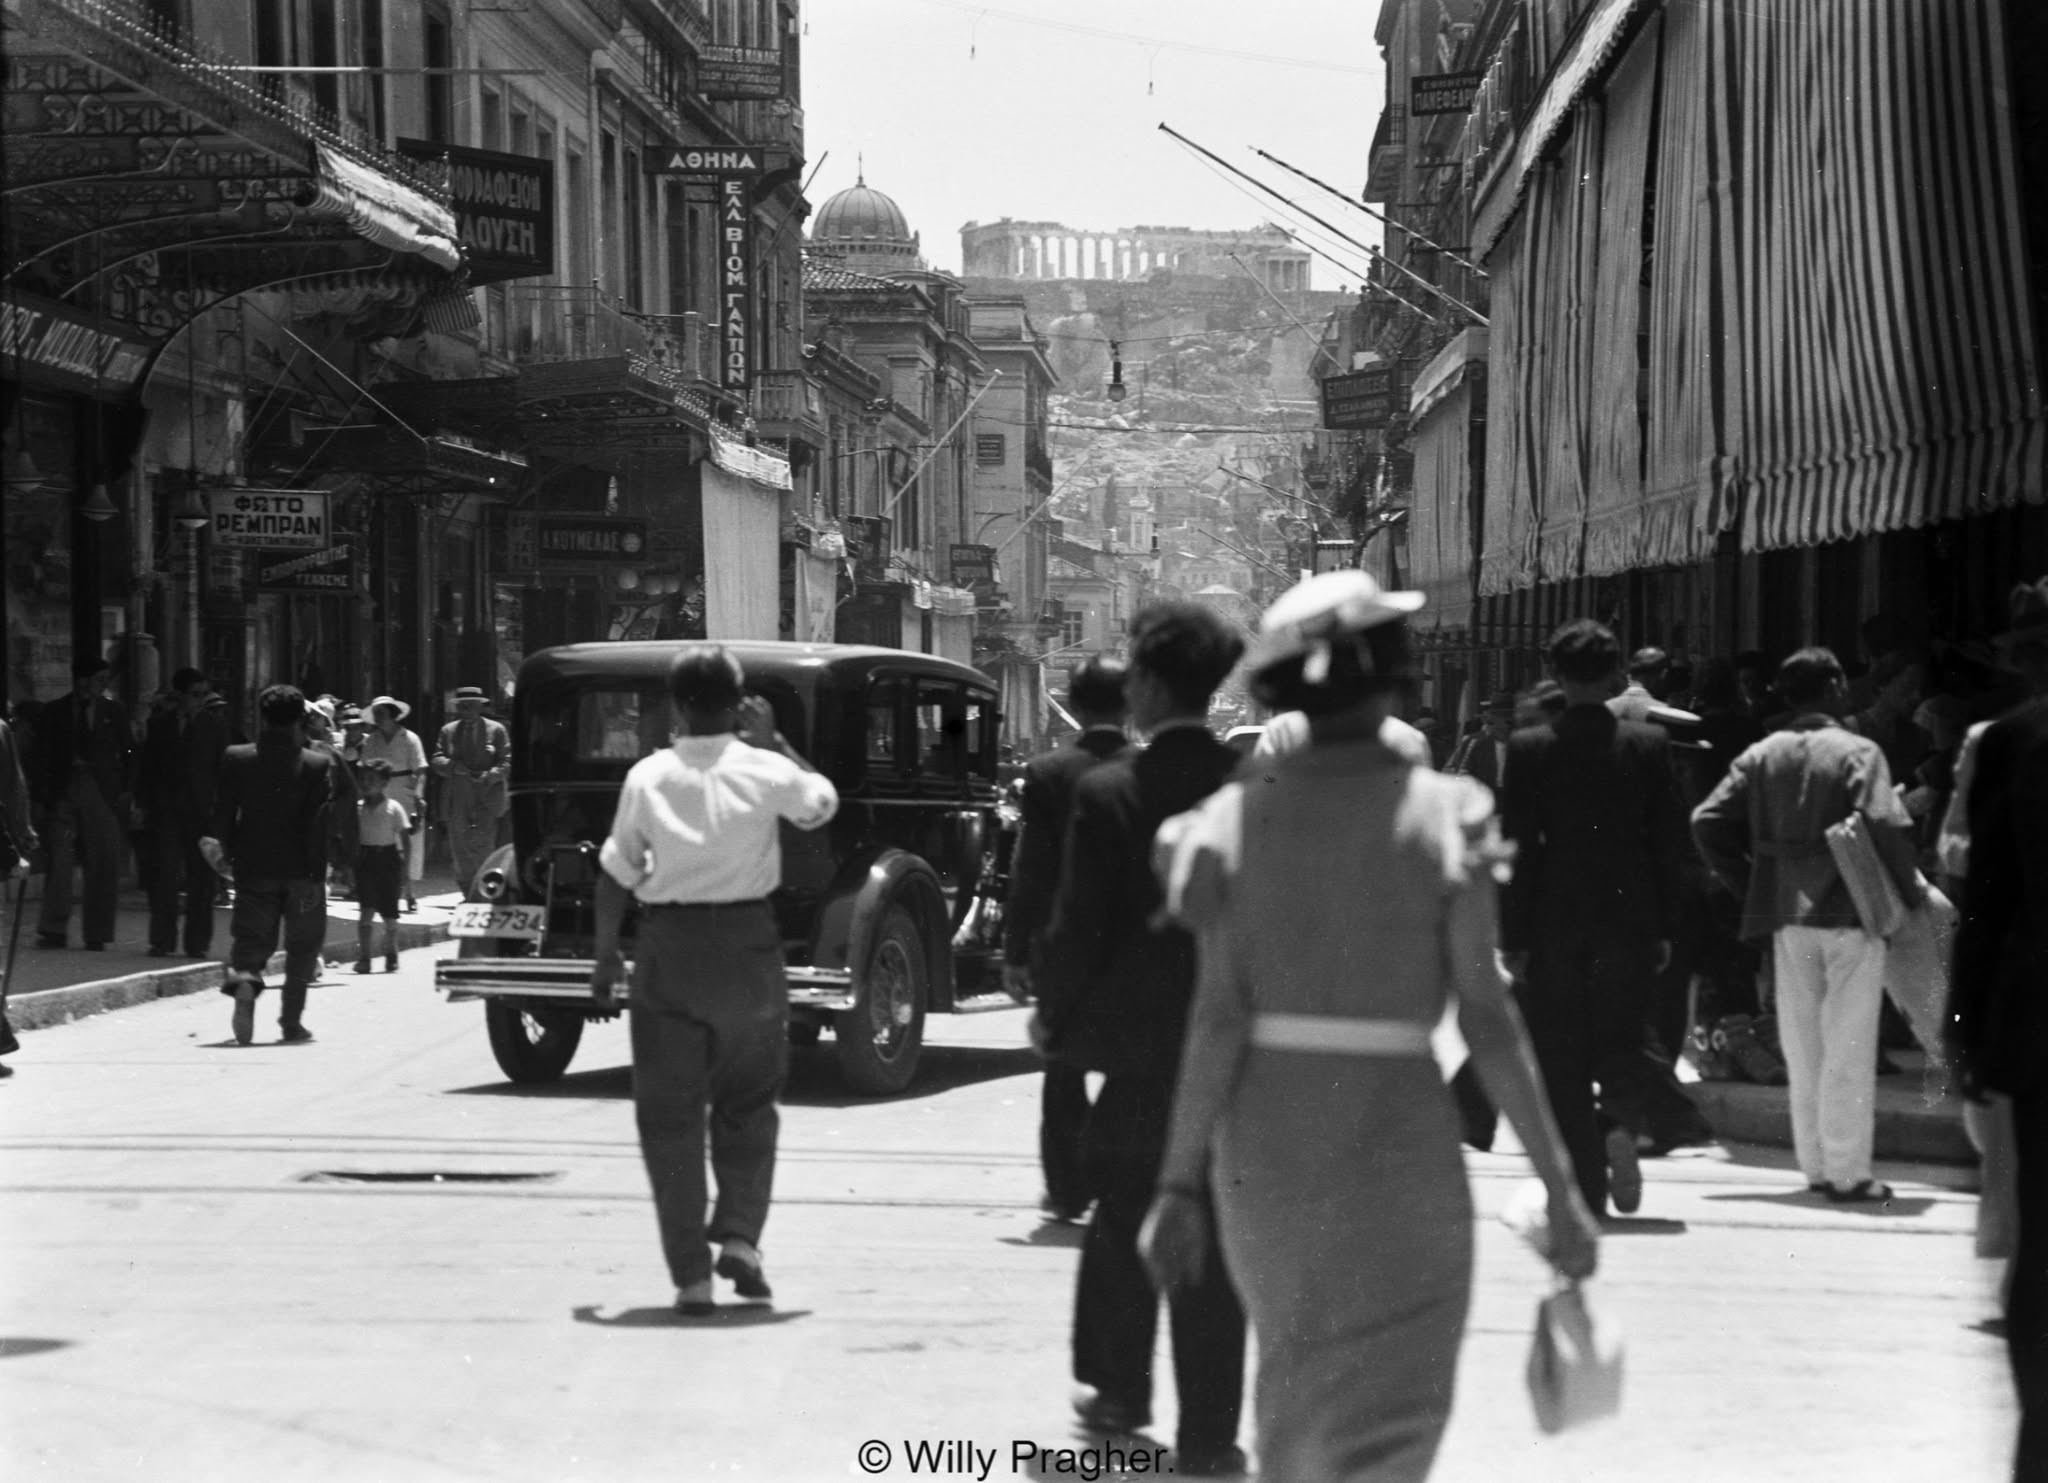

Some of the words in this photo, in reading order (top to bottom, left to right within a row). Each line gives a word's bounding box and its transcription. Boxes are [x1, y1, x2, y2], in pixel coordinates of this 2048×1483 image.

[668, 151, 756, 169] ΑΘΗΝΑ
[457, 214, 535, 257] ΑΟΥΣΗ
[234, 496, 304, 512] ΦΩΤΟ
[217, 514, 321, 535] ΡΕΜΠΡΑΝ
